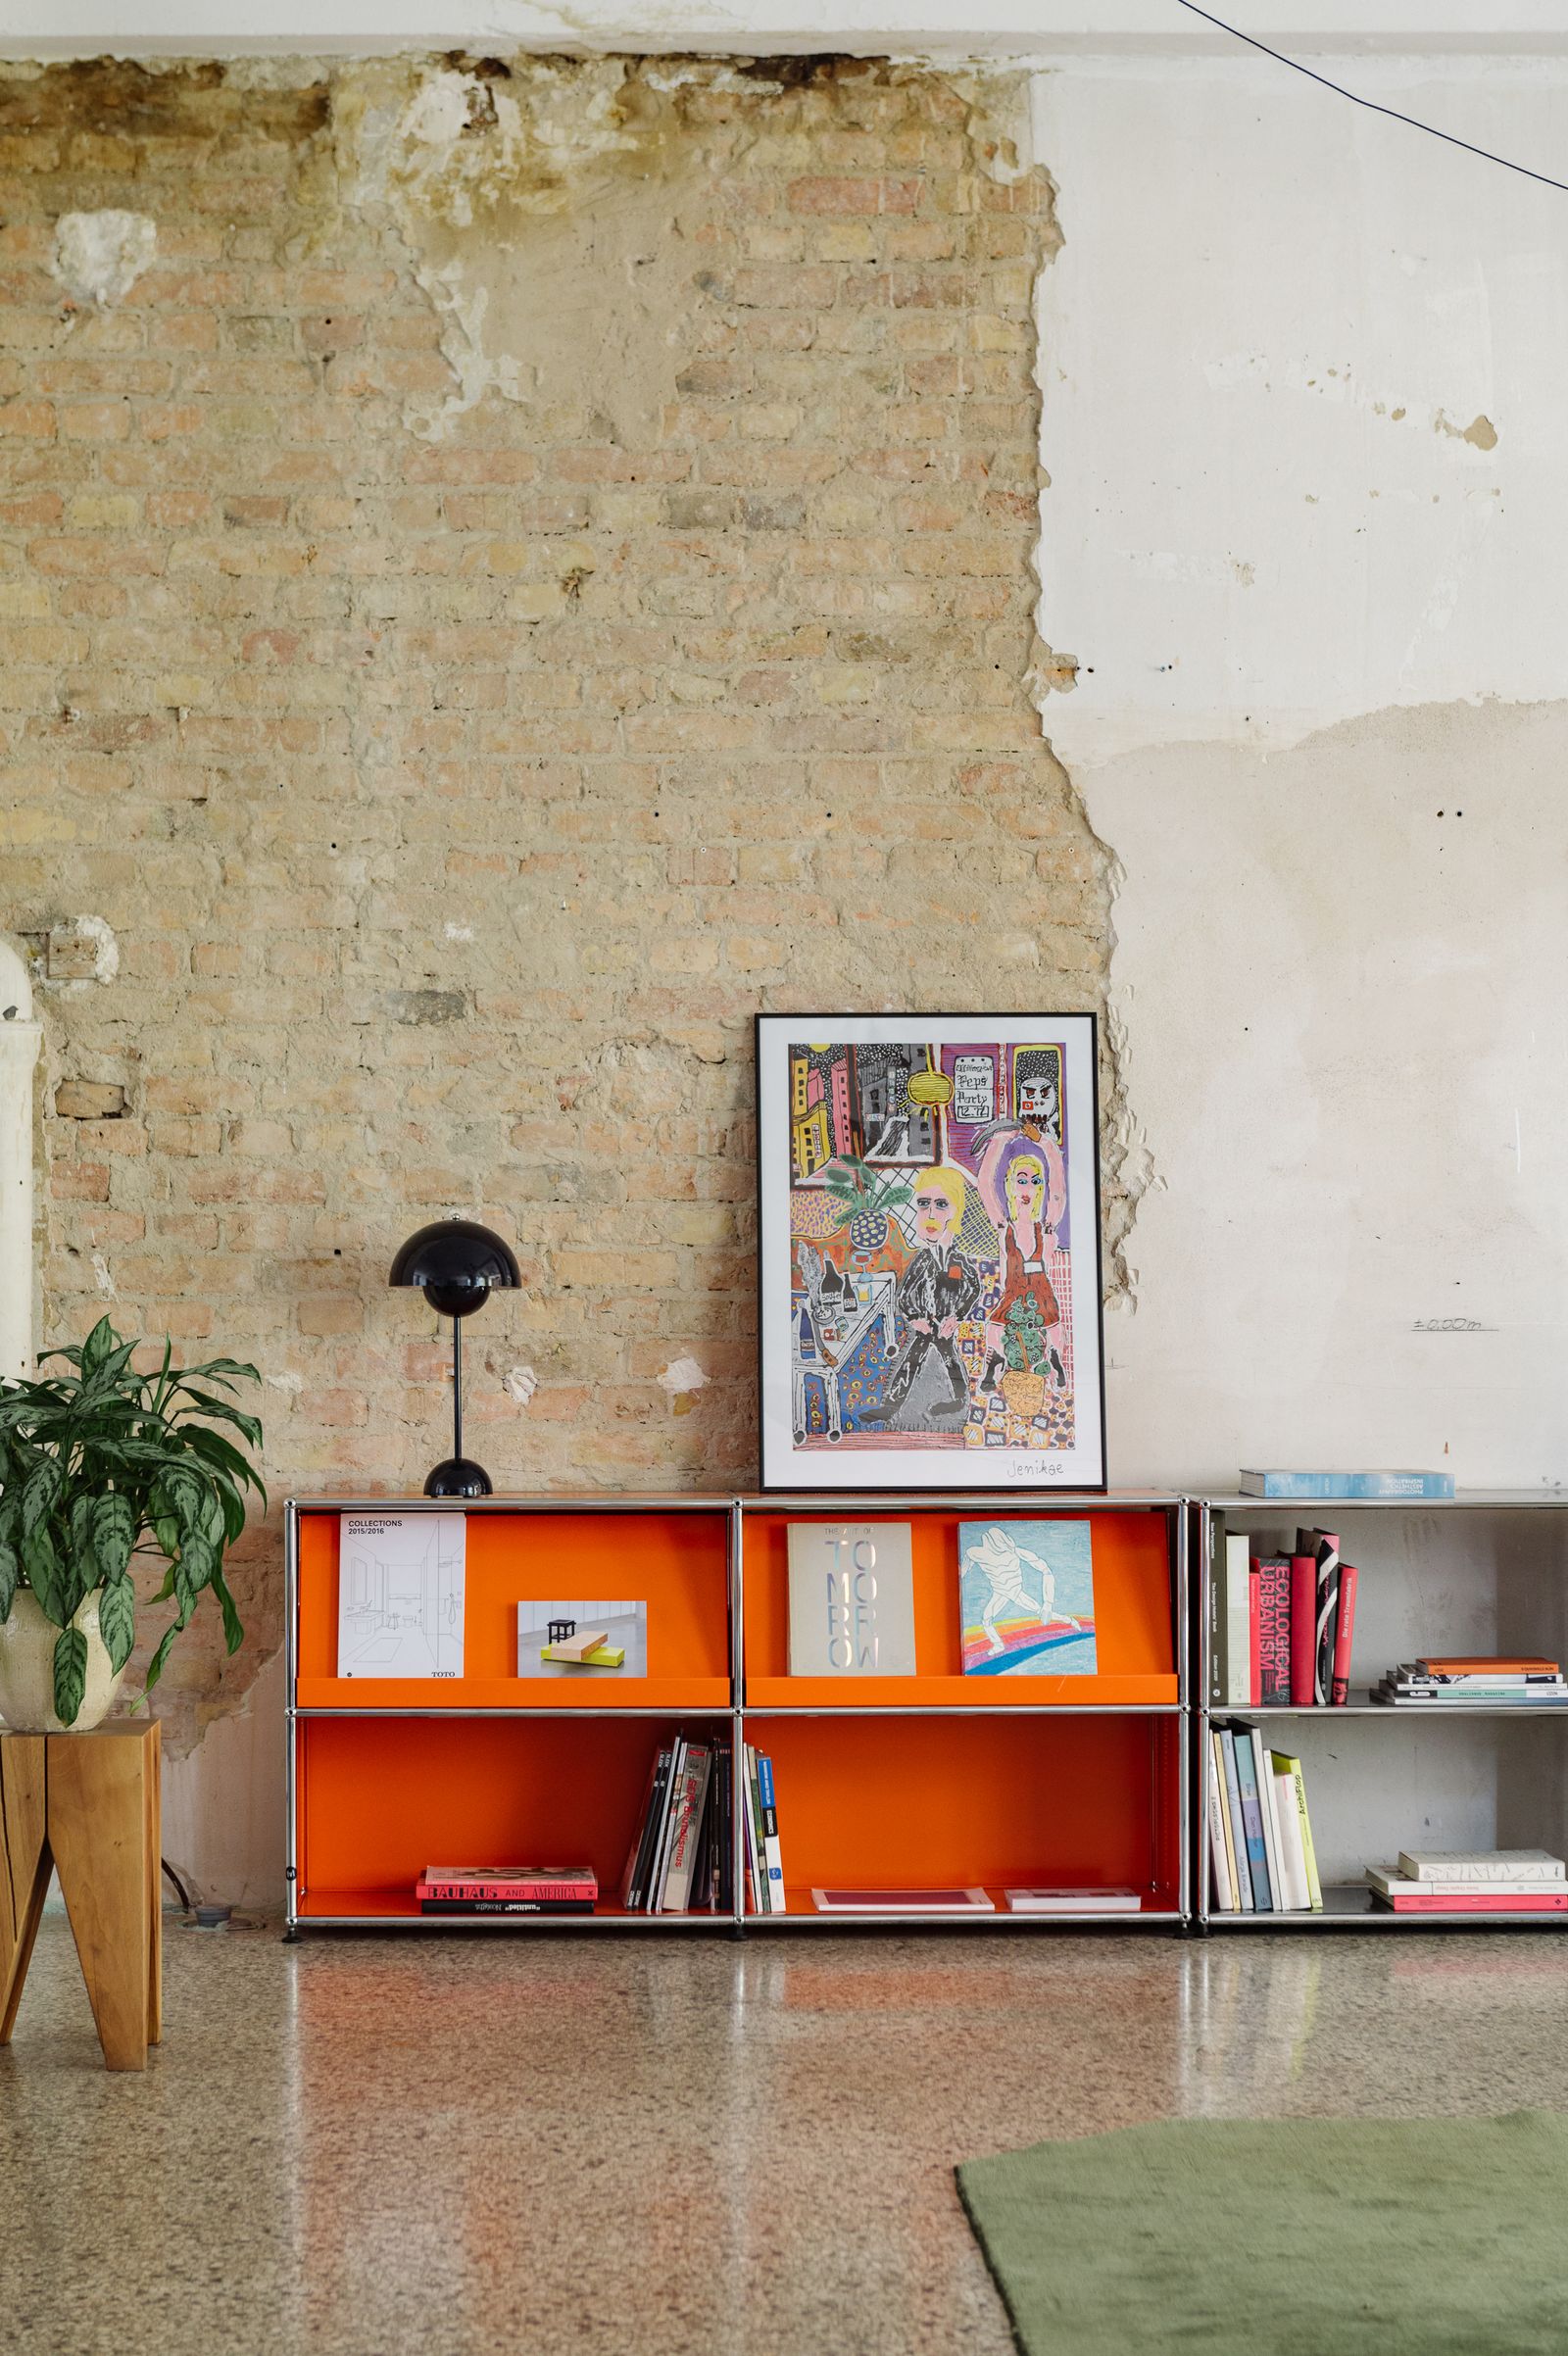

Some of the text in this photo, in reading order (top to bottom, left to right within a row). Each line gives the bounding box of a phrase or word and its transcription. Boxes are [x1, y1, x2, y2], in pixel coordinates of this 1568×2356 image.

[1260, 1566, 1275, 1670] URBANISM
[1274, 1566, 1291, 1692] ECOLOGICAL
[675, 1780, 696, 1869] SOS Brutalismus
[427, 1887, 498, 1898] BAUHAUS
[532, 1888, 577, 1898] AMERICA
